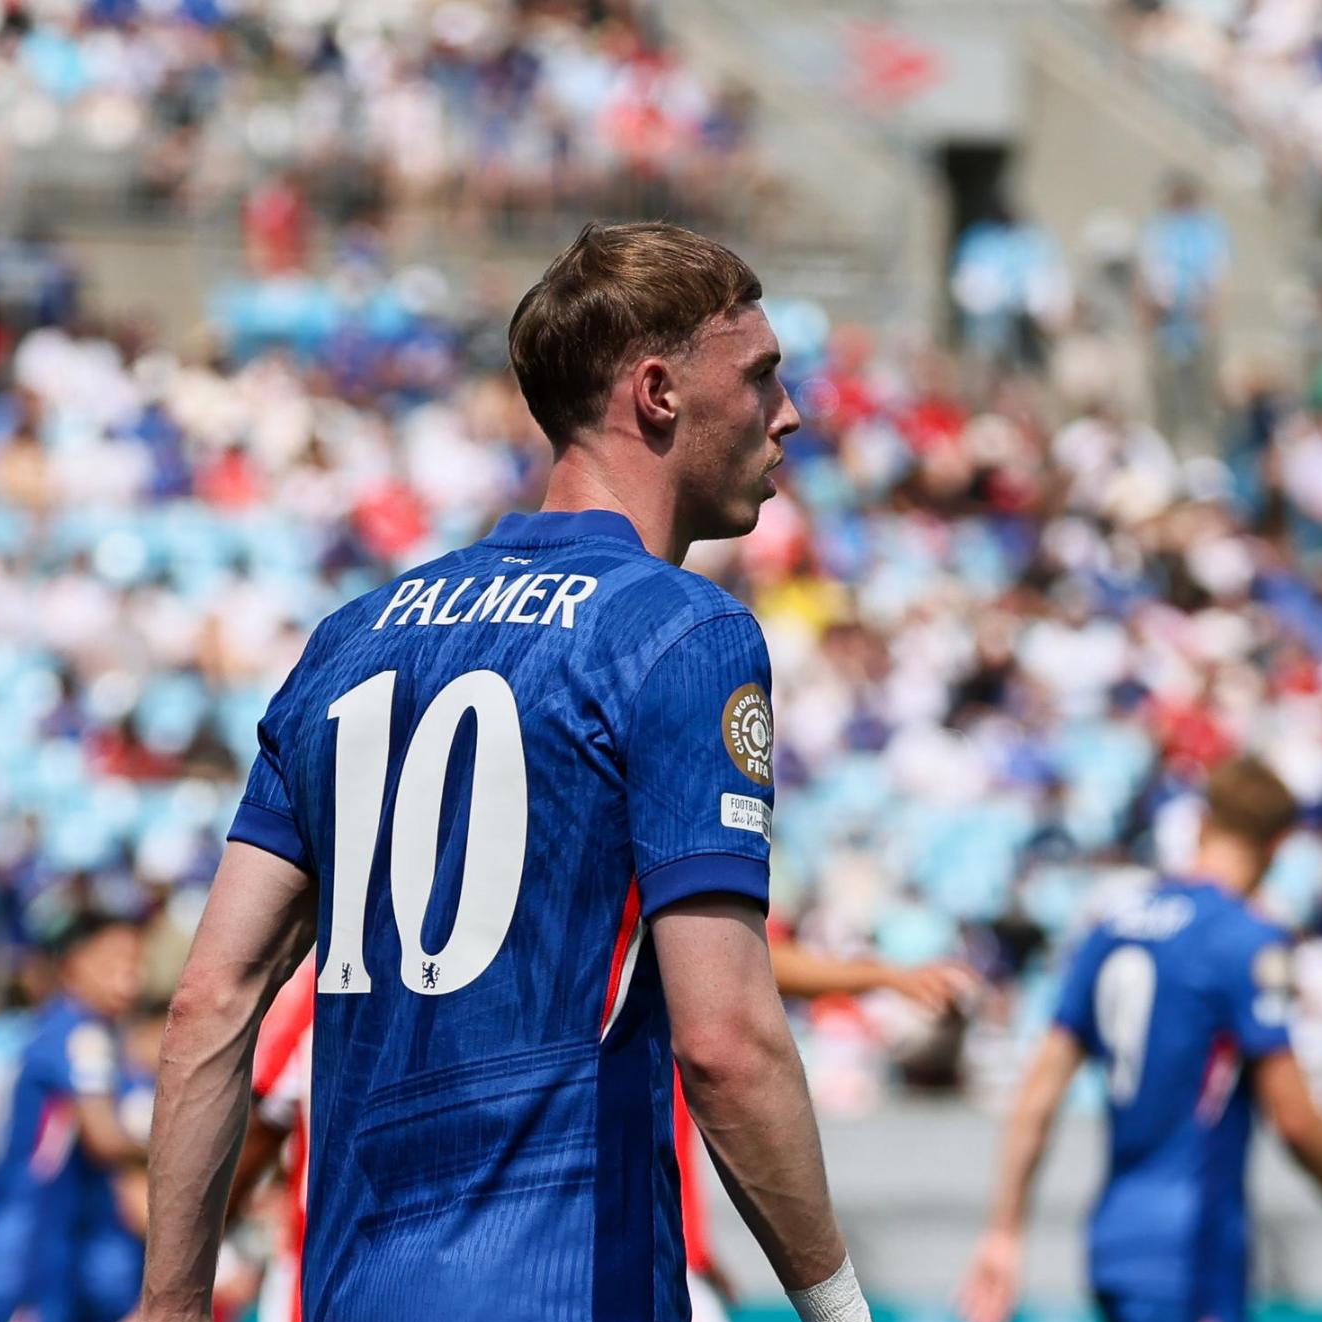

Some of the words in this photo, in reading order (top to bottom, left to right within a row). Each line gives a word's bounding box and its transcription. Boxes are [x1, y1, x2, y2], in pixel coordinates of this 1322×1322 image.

[372, 573, 599, 629] PALMER
[733, 693, 760, 718] WORLD
[730, 721, 745, 755] CLUB
[747, 758, 769, 779] FIFA
[317, 668, 528, 996] 10
[1093, 943, 1157, 1108] 9
